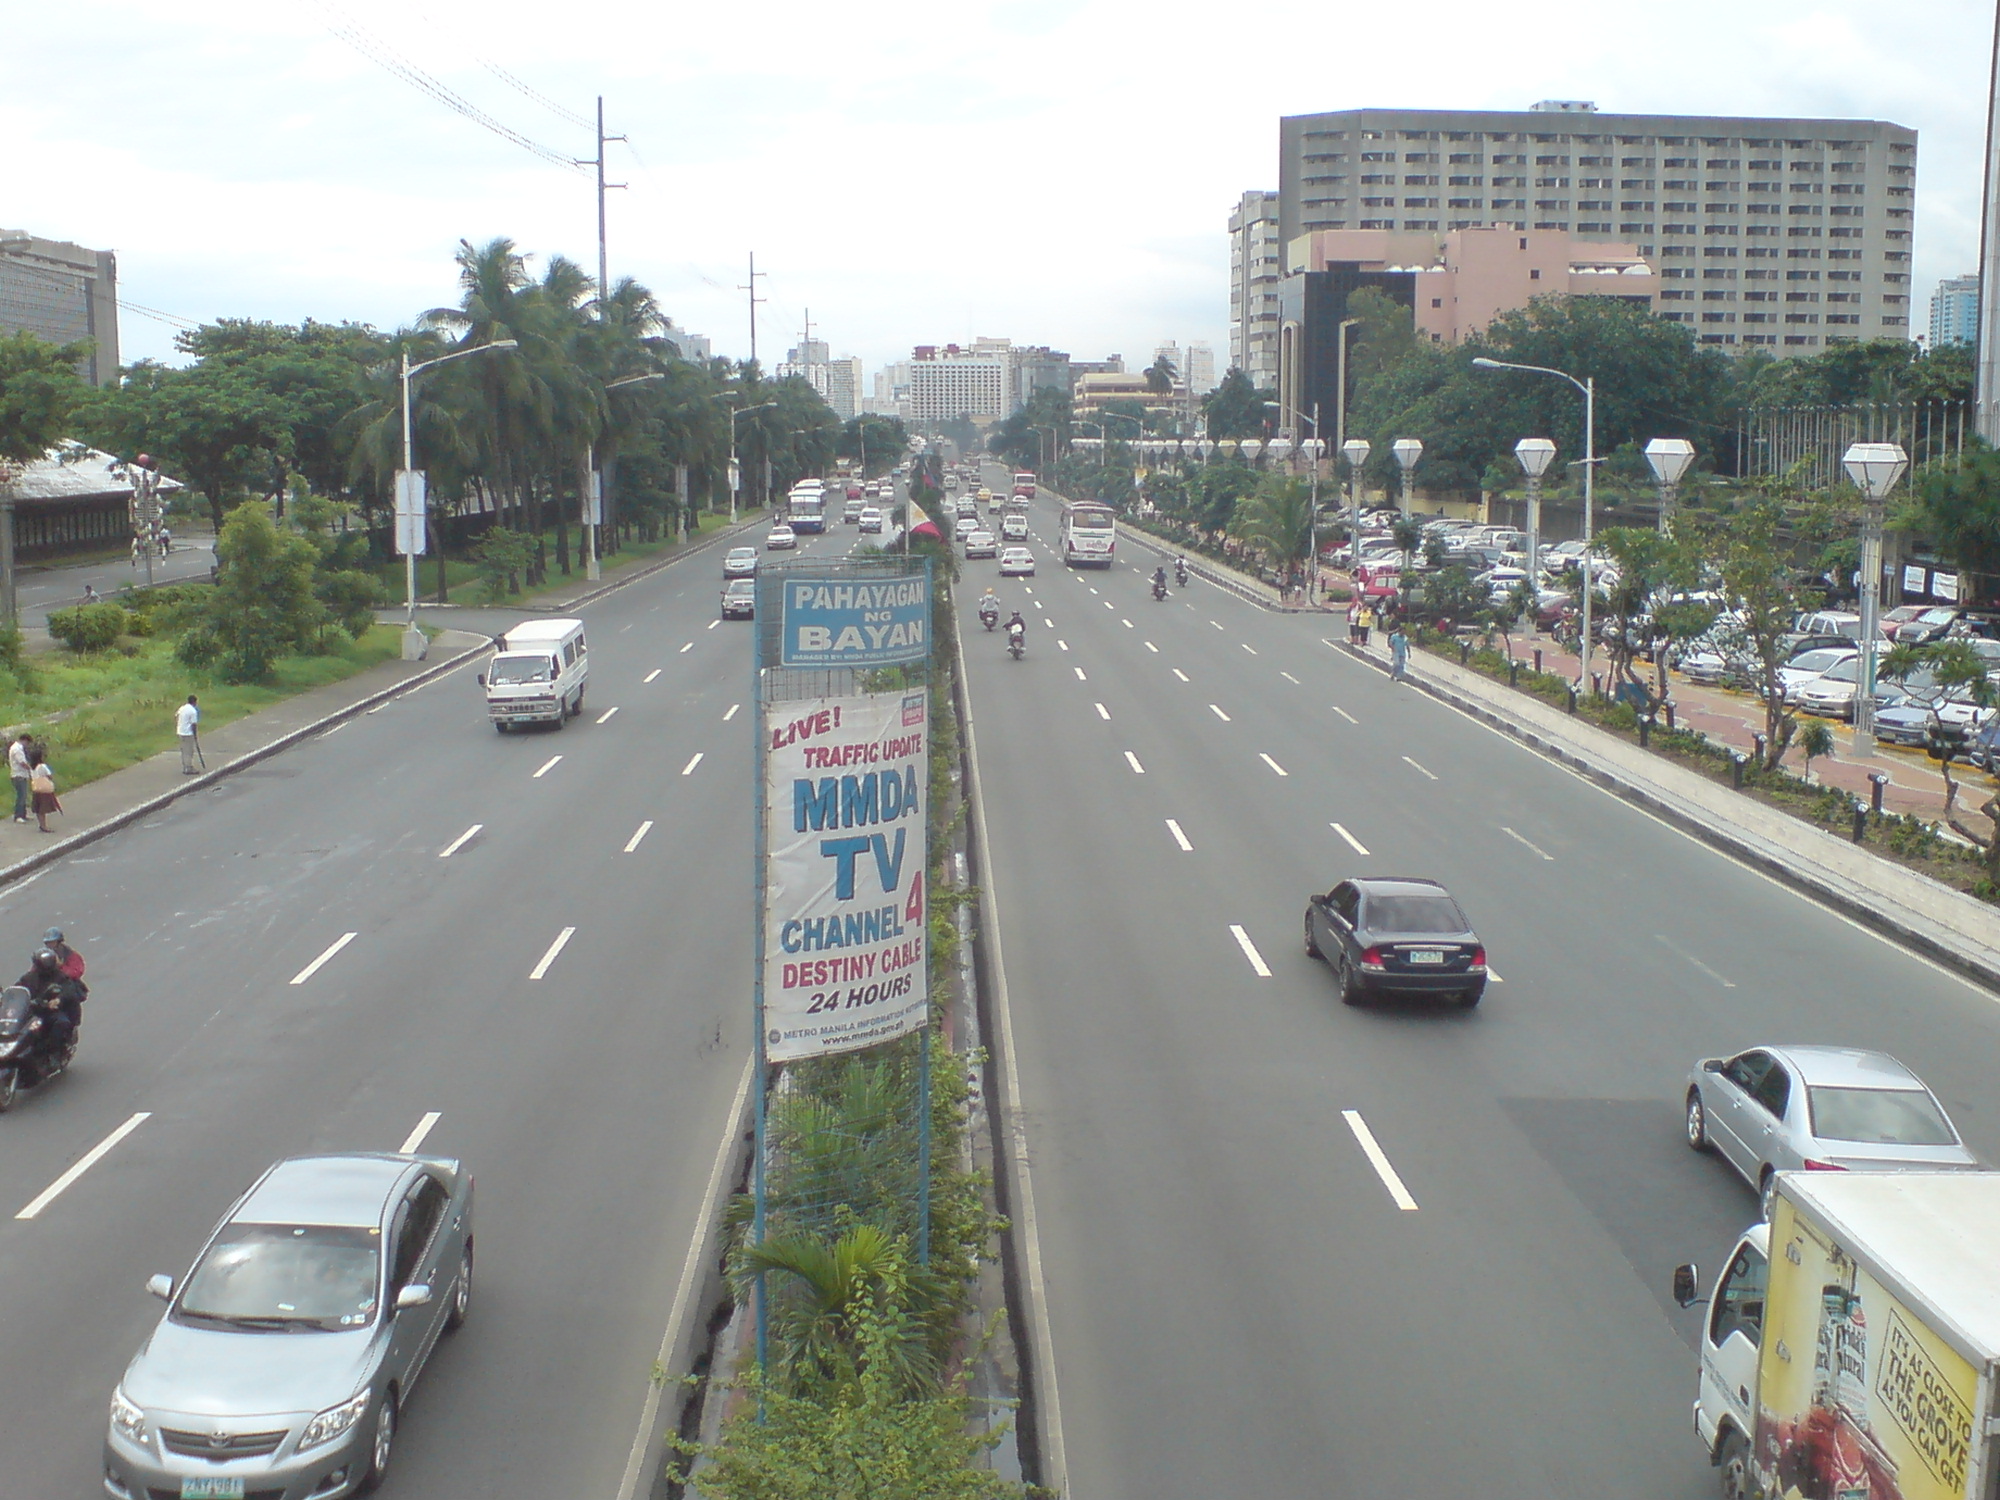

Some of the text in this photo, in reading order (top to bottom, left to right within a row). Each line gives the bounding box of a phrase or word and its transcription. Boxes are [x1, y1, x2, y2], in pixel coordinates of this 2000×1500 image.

[795, 581, 924, 610] PAHAYAGAN
[864, 611, 892, 622] NG
[798, 620, 923, 651] BAYAN
[772, 705, 841, 750] LIVE!
[803, 733, 922, 769] TRAFFIC UPDATE
[793, 764, 919, 833] MMDA
[820, 827, 906, 901] TV
[780, 870, 923, 954] CHANNEL 4
[782, 937, 921, 989] DESTINY CABLE
[806, 973, 912, 1014] 24 HOURS
[783, 1027, 818, 1040] METRO
[819, 1021, 857, 1035] MANILA
[1891, 1326, 1972, 1443] IT'S AS CLOSE TO
[1889, 1348, 1967, 1475] THE GROVE
[1882, 1378, 1962, 1494] AS YOU CAN GET
